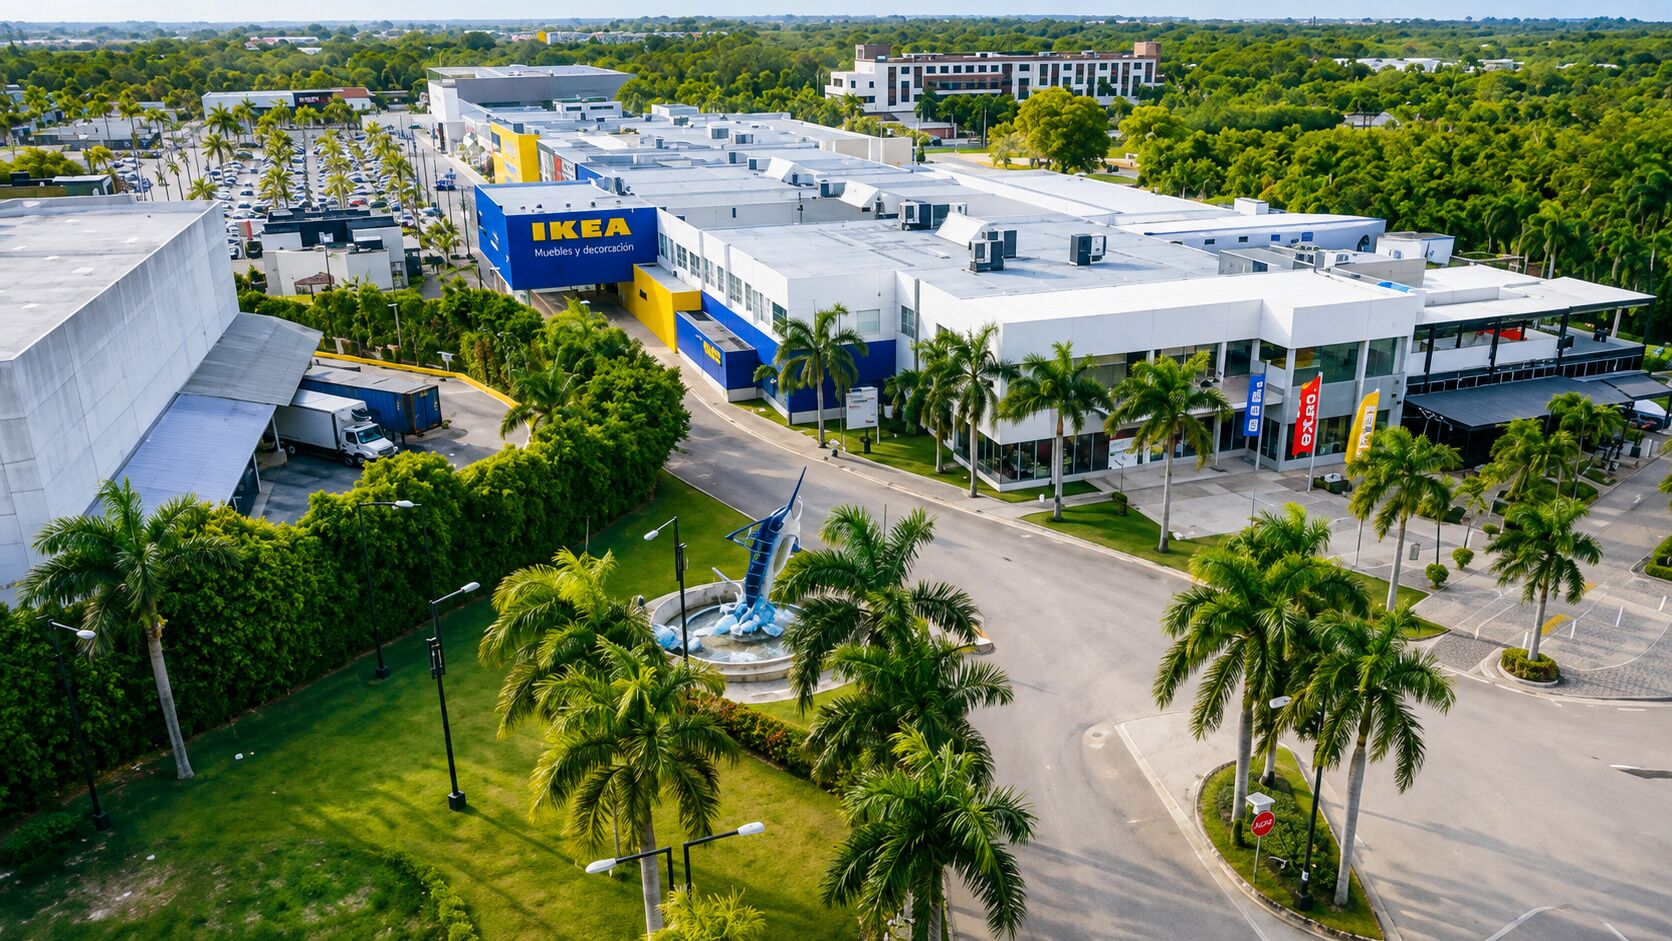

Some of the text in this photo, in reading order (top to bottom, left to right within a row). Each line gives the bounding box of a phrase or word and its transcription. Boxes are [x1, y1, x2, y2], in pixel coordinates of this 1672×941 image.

[532, 218, 632, 240] IKEA
[535, 247, 572, 257] Muebles
[574, 248, 580, 257] y
